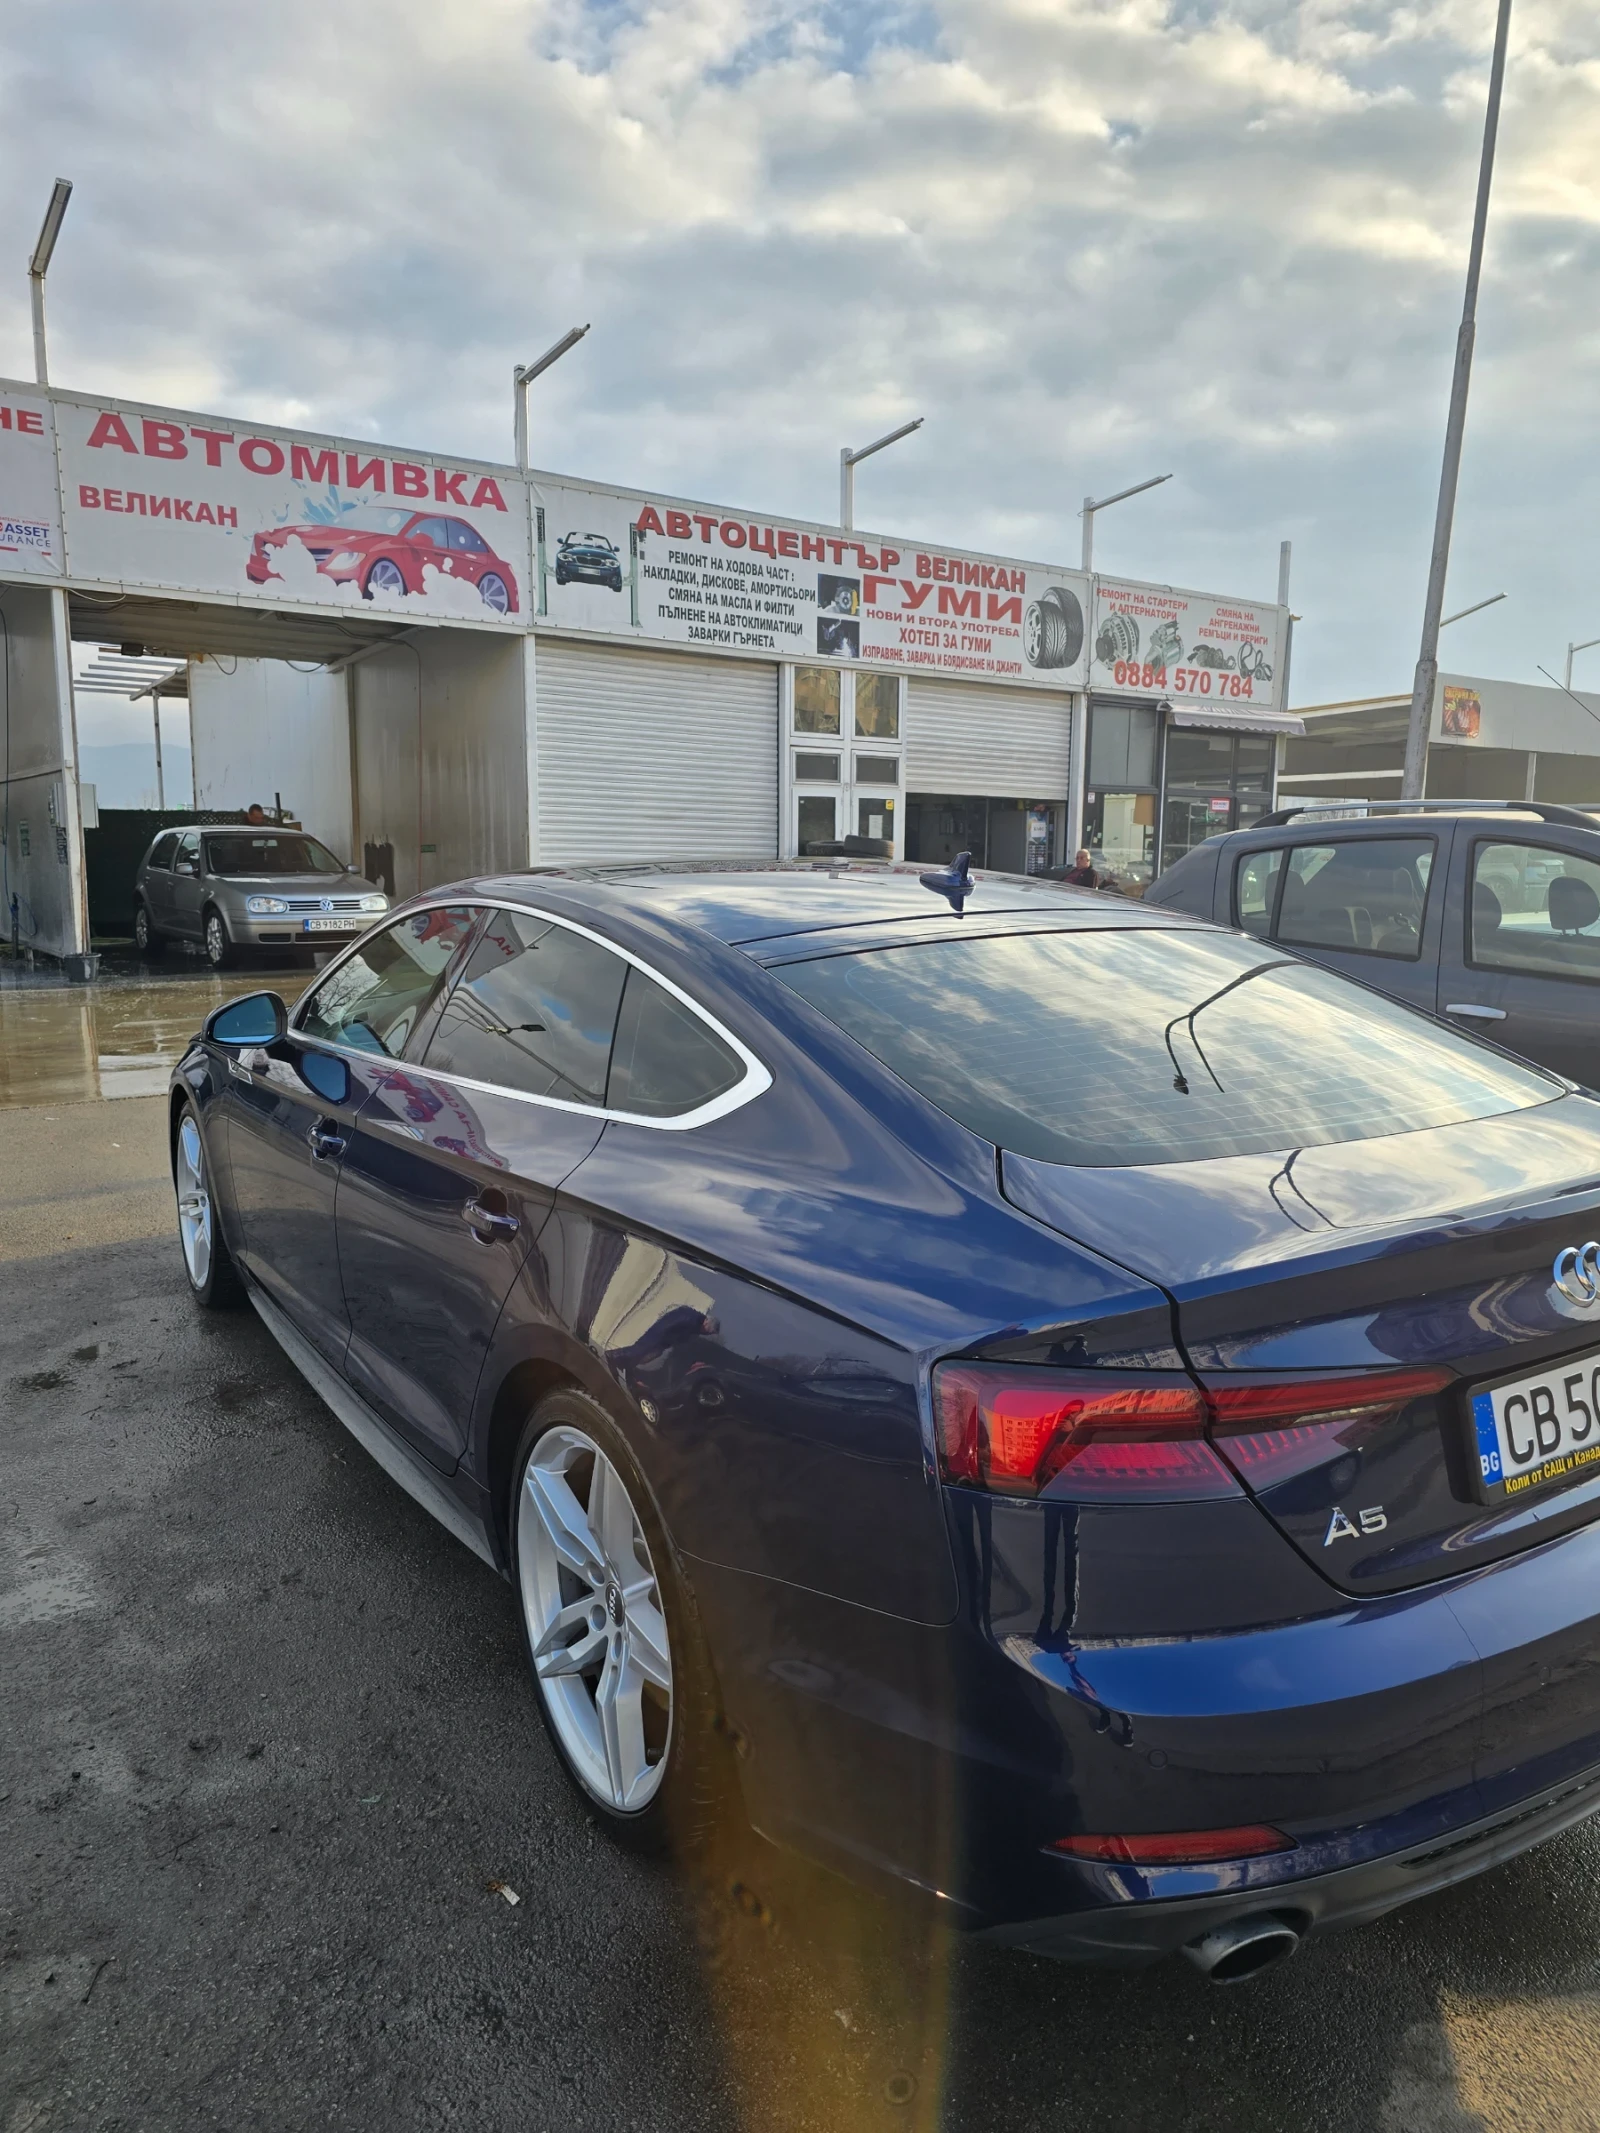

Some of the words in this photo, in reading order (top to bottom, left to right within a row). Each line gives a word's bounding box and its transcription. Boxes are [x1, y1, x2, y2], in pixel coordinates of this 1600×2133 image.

[86, 412, 509, 512] АВТОМИВКА
[78, 484, 239, 528] ВЕЛИКАН
[5, 523, 50, 538] ASSET
[636, 505, 901, 573] АВТОЦЕНТЪР
[916, 553, 1026, 595] ВЕЛИКАН
[668, 550, 708, 569] РЕМОНТ
[710, 557, 724, 571] НА
[726, 559, 764, 577] ХОДОВА
[766, 565, 789, 581] ЧАСТ
[643, 564, 700, 588] НАКЛАДКИ,
[701, 573, 748, 596] ДИСКОВЕ,
[751, 581, 816, 603] АМОРТИСЬОРИ
[668, 587, 703, 604] СМЯНА
[705, 592, 719, 606] НА
[720, 594, 753, 612] МАСЛА
[755, 599, 762, 612] И
[764, 600, 795, 617] ФИЛТИ
[863, 573, 1023, 625] ГУМИ
[1096, 587, 1132, 602] РЕМОНТ
[1133, 593, 1145, 605] НА
[1147, 595, 1189, 612] СТАРТЕРИ
[1109, 601, 1116, 612] И
[1118, 602, 1178, 621] АЛТЕРНАТОРИ
[658, 604, 706, 623] ПЪЛНЕНЕ
[708, 611, 721, 625] НА
[723, 613, 803, 637] АВТОКЛИМАТИЦИ
[866, 608, 903, 622] НОВИ
[906, 613, 915, 624] И
[918, 615, 958, 630] ВТОРА
[960, 621, 1020, 638] УПОТРЕБА
[1208, 618, 1260, 633] АНГРЕНАЖНИ
[1216, 607, 1243, 621] СМЯНА
[1244, 612, 1255, 622] НА
[688, 625, 731, 643] ЗАВАРКИ
[733, 631, 775, 649] ГЪРНЕТА
[899, 626, 940, 648] ХОТЕЛ
[943, 632, 958, 650] ЗА
[961, 634, 992, 653] ГУМИ
[1198, 627, 1232, 641] РЕМЪЦИ
[1233, 632, 1239, 642] И
[1240, 633, 1269, 646] ВЕРИГИ
[862, 644, 905, 664] ИЗПРАВЯНЕ,
[906, 649, 936, 666] ЗАВАРКА
[937, 653, 942, 666] И
[943, 653, 985, 671] БОЯДИСВАНЕ
[986, 658, 995, 672] НА
[996, 660, 1023, 675] ДЖАНТИ
[1114, 659, 1168, 690] 0884
[1174, 667, 1212, 695] 570
[1218, 673, 1254, 699] 784
[1480, 1451, 1500, 1477] BG
[1504, 1473, 1531, 1494] Коли
[1531, 1468, 1543, 1483] от
[1543, 1458, 1567, 1478] САЩ
[1567, 1456, 1574, 1469] и
[1323, 1505, 1388, 1547] A5
